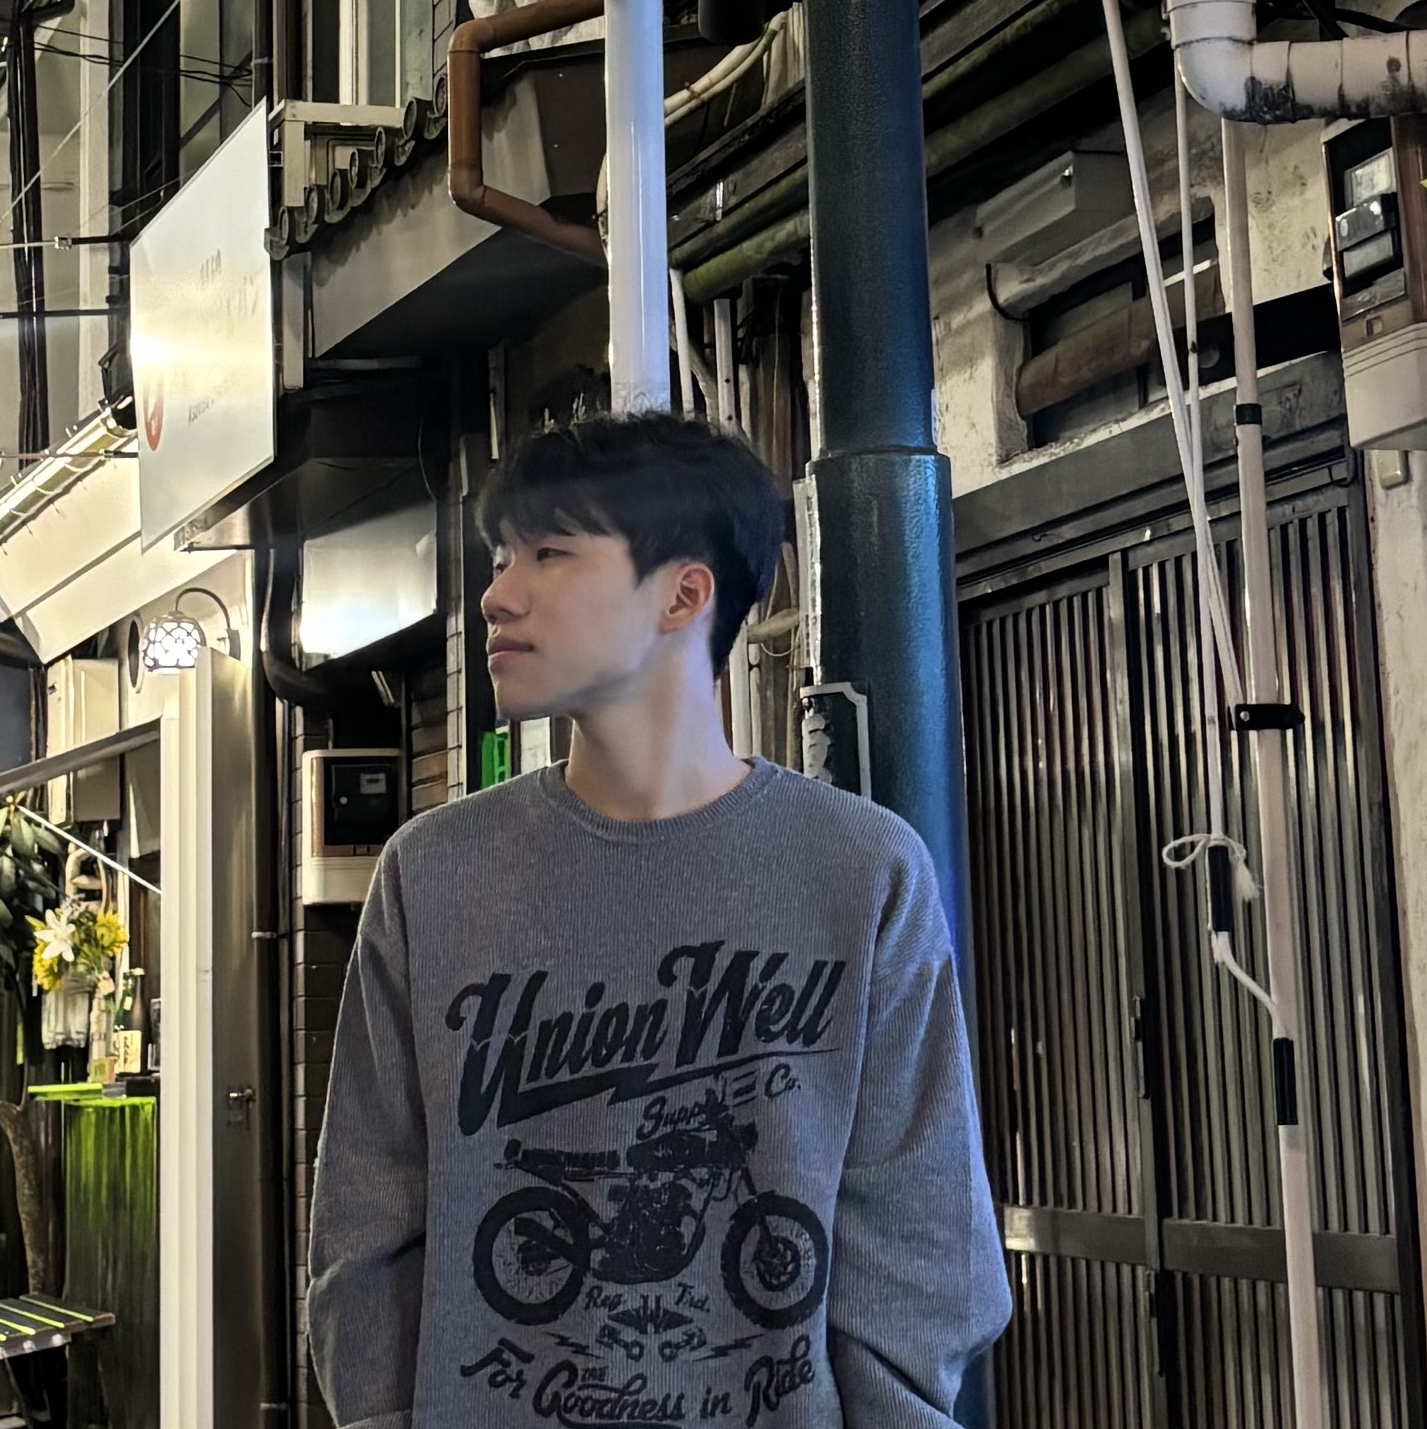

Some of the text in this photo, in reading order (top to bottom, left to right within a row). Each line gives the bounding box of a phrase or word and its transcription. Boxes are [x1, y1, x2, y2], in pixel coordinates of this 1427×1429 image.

[446, 940, 847, 1136] Union Well
[460, 1338, 535, 1399] For
[699, 1387, 733, 1419] in
